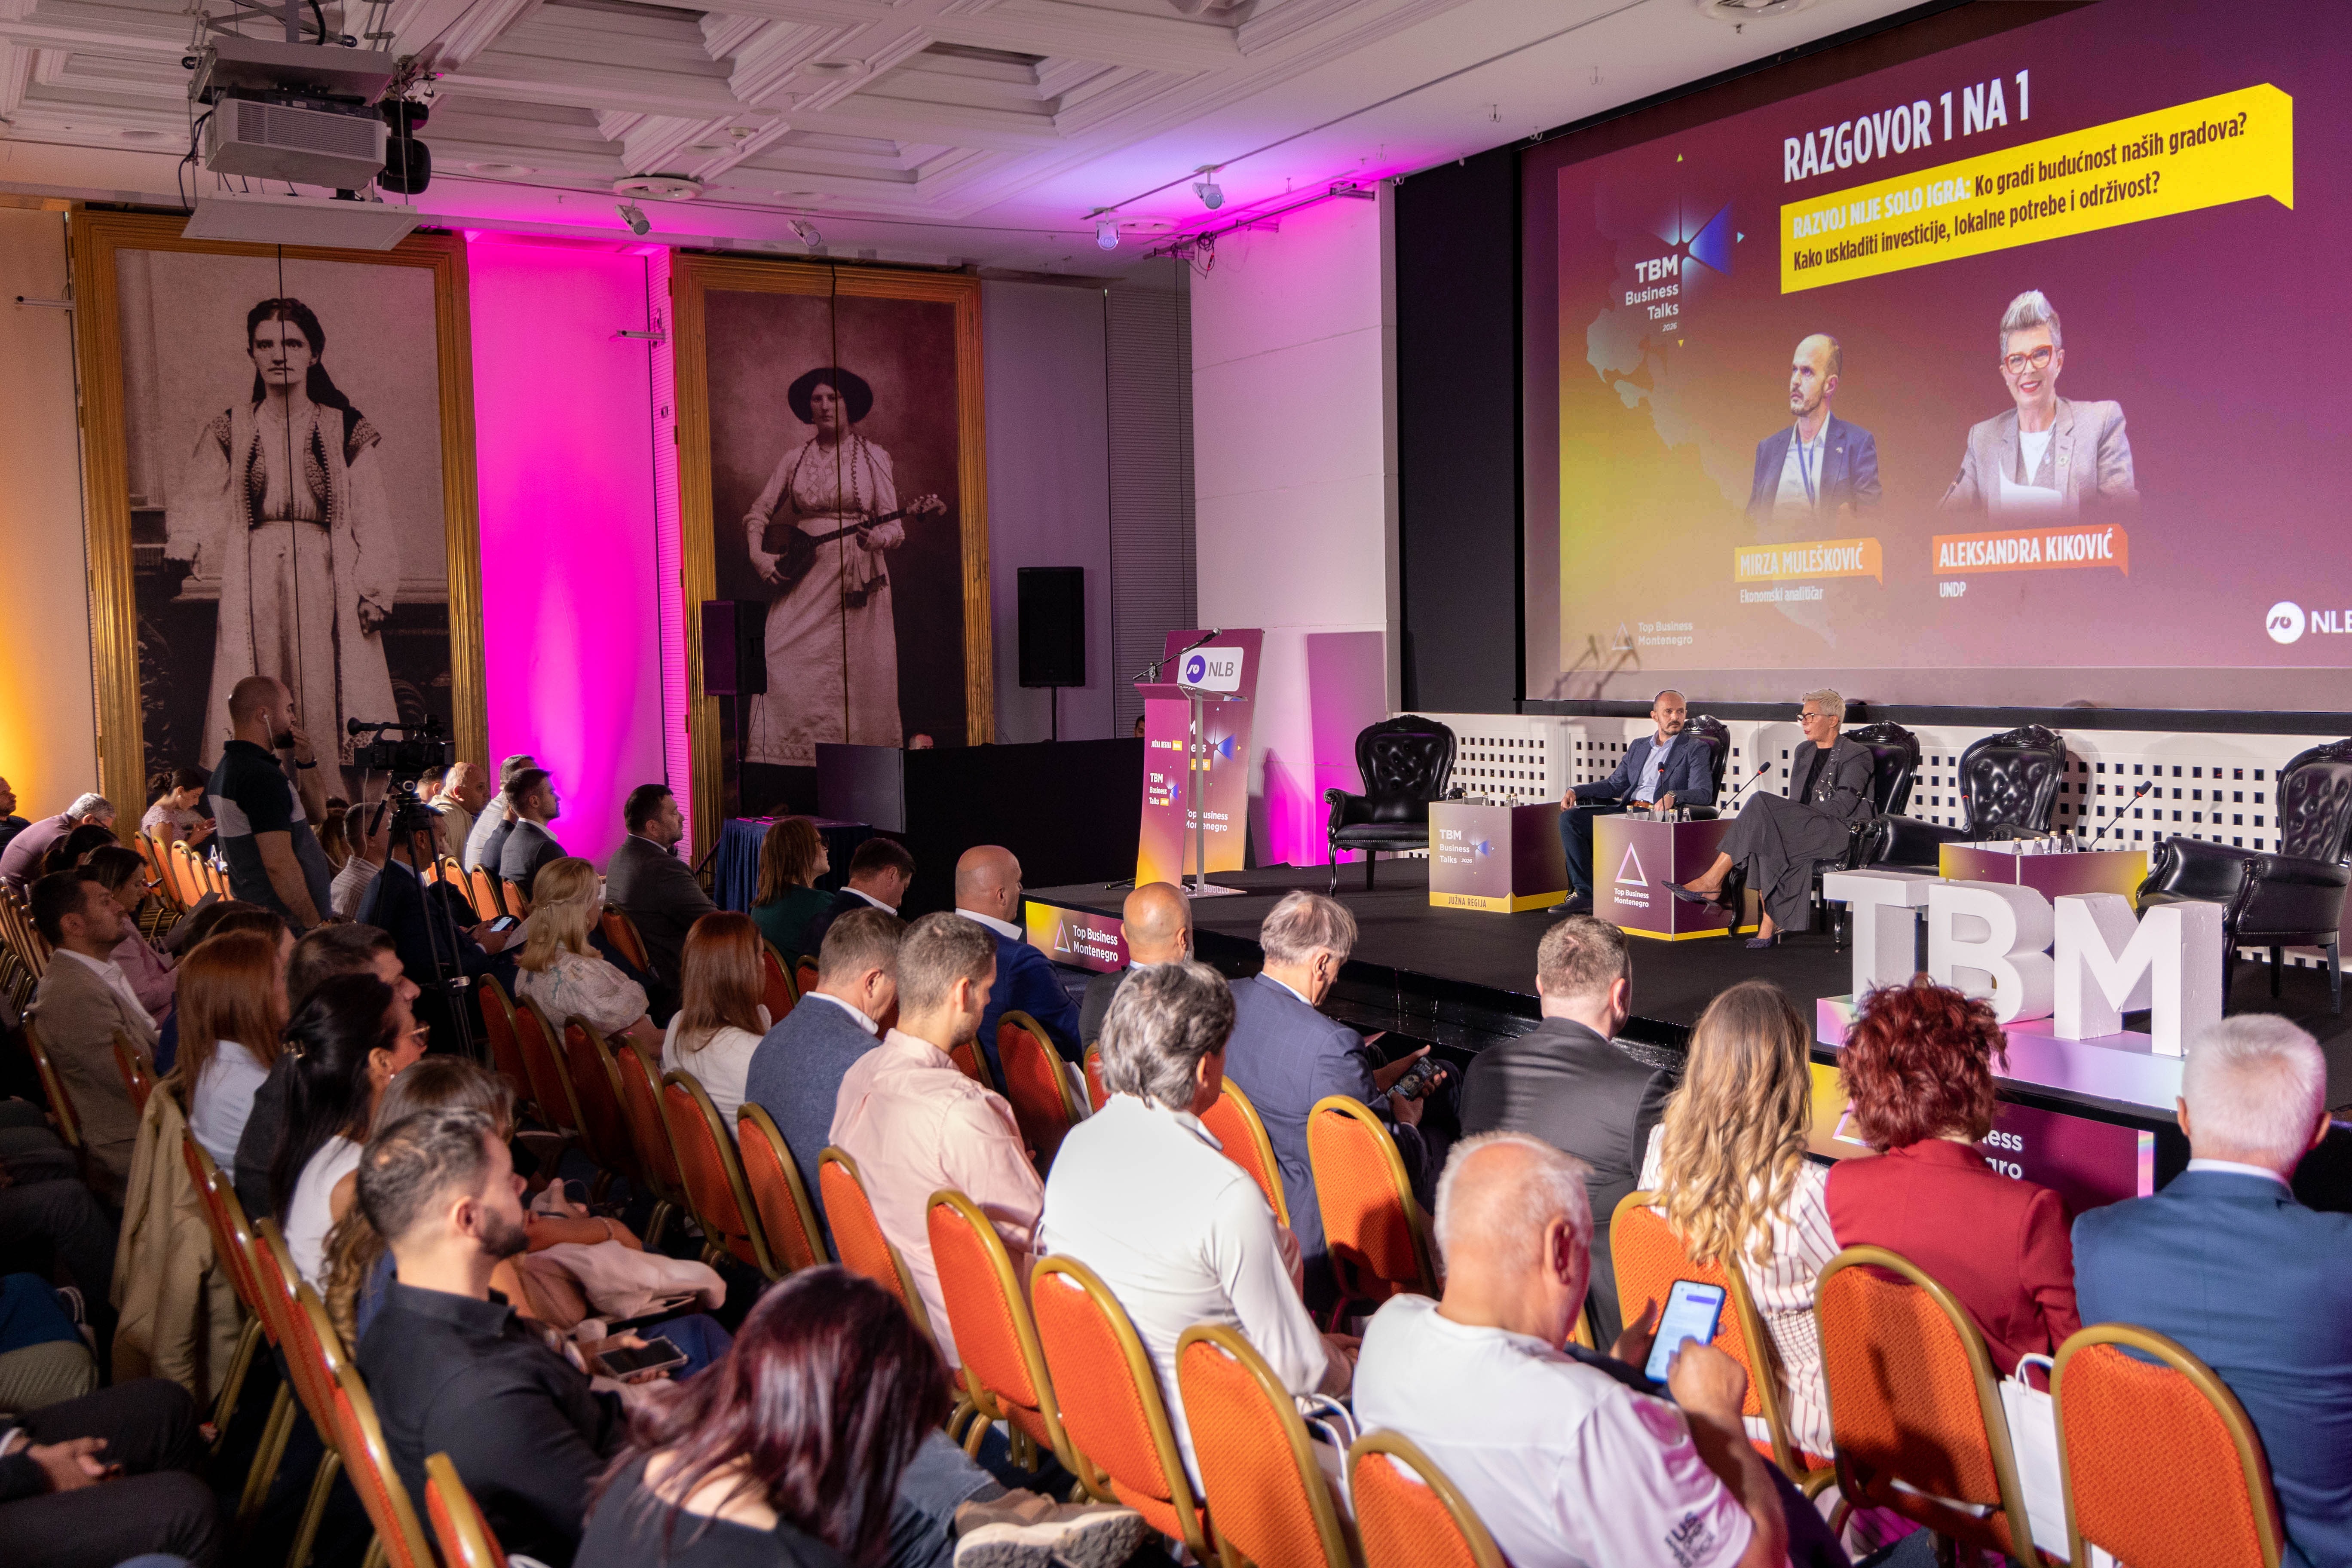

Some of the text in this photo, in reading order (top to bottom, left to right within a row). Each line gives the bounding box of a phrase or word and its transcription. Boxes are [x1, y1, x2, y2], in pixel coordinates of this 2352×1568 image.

[1784, 69, 2029, 184] RAZGOVOR 1 NA 1
[1793, 112, 2247, 239] RAZVOJ NIJE SOLO IGRA: Ko gradi budućnost naših gradova?
[1794, 171, 2160, 271] Kako uskladiti investicije, lokalne potrebe i održivost?
[1635, 254, 1678, 283] TBM
[1626, 284, 1678, 306] Business
[1647, 303, 1678, 320] Talks
[1939, 527, 2113, 567] ALEKSANDRA KIKOVIĆ
[1740, 542, 1863, 576] MIRZA MULEŠKOVIĆ
[1939, 582, 1966, 597] UNDP
[1638, 621, 1692, 633] Top Business
[1638, 636, 1692, 646] Montenegro
[1208, 662, 1234, 677] NLB
[1150, 773, 1163, 783] TBM
[1149, 787, 1167, 795] Business
[1204, 811, 1228, 820] usiness
[1439, 829, 1461, 840] TBM
[1439, 844, 1470, 853] Business
[1439, 855, 1457, 864] Talks
[1449, 895, 1486, 907] JUŽNA REGIJA
[1614, 888, 1649, 899] Top Business
[1614, 897, 1649, 908] Montenegro
[1073, 925, 1118, 945] Top Business
[1074, 941, 1118, 962] Montenegro
[1823, 870, 2222, 1056] TBM
